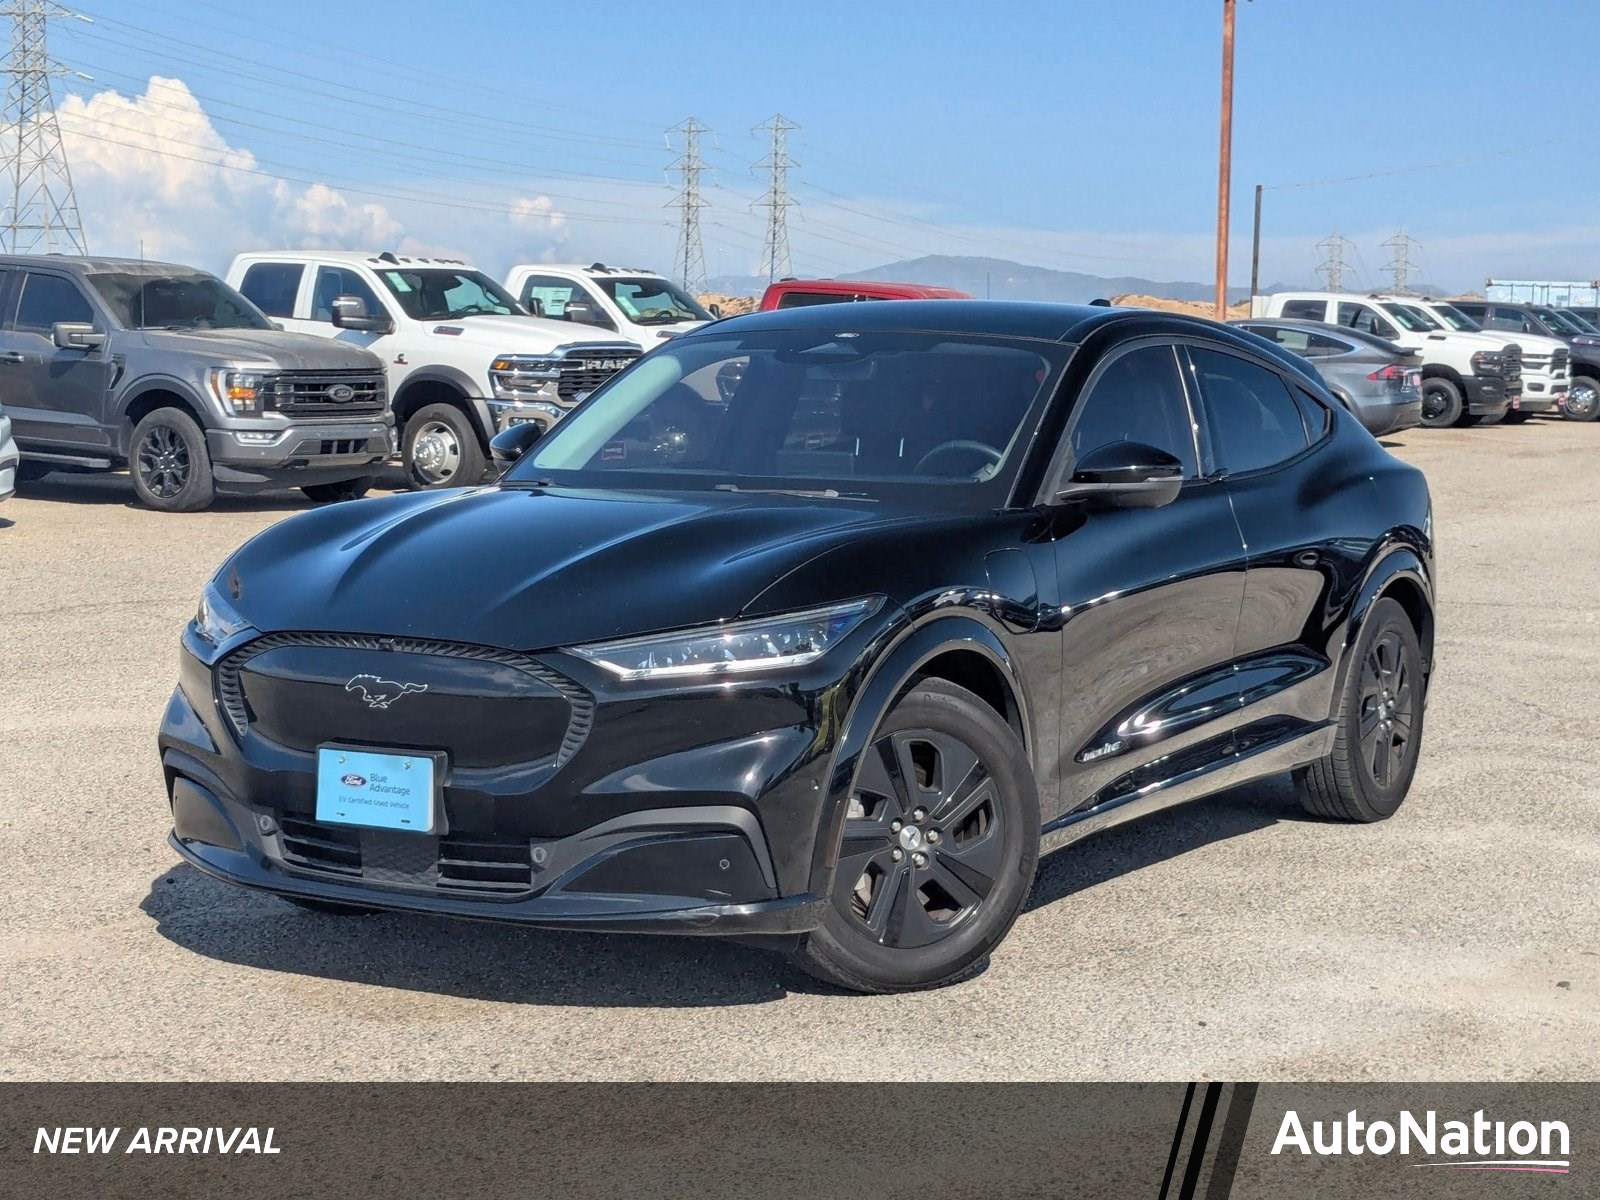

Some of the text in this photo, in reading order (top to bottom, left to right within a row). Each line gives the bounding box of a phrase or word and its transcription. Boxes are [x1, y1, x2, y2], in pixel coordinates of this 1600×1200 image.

[370, 773, 388, 783] Blue
[369, 783, 411, 796] Advantage
[347, 796, 372, 806] Certified
[389, 801, 410, 809] Vehicle
